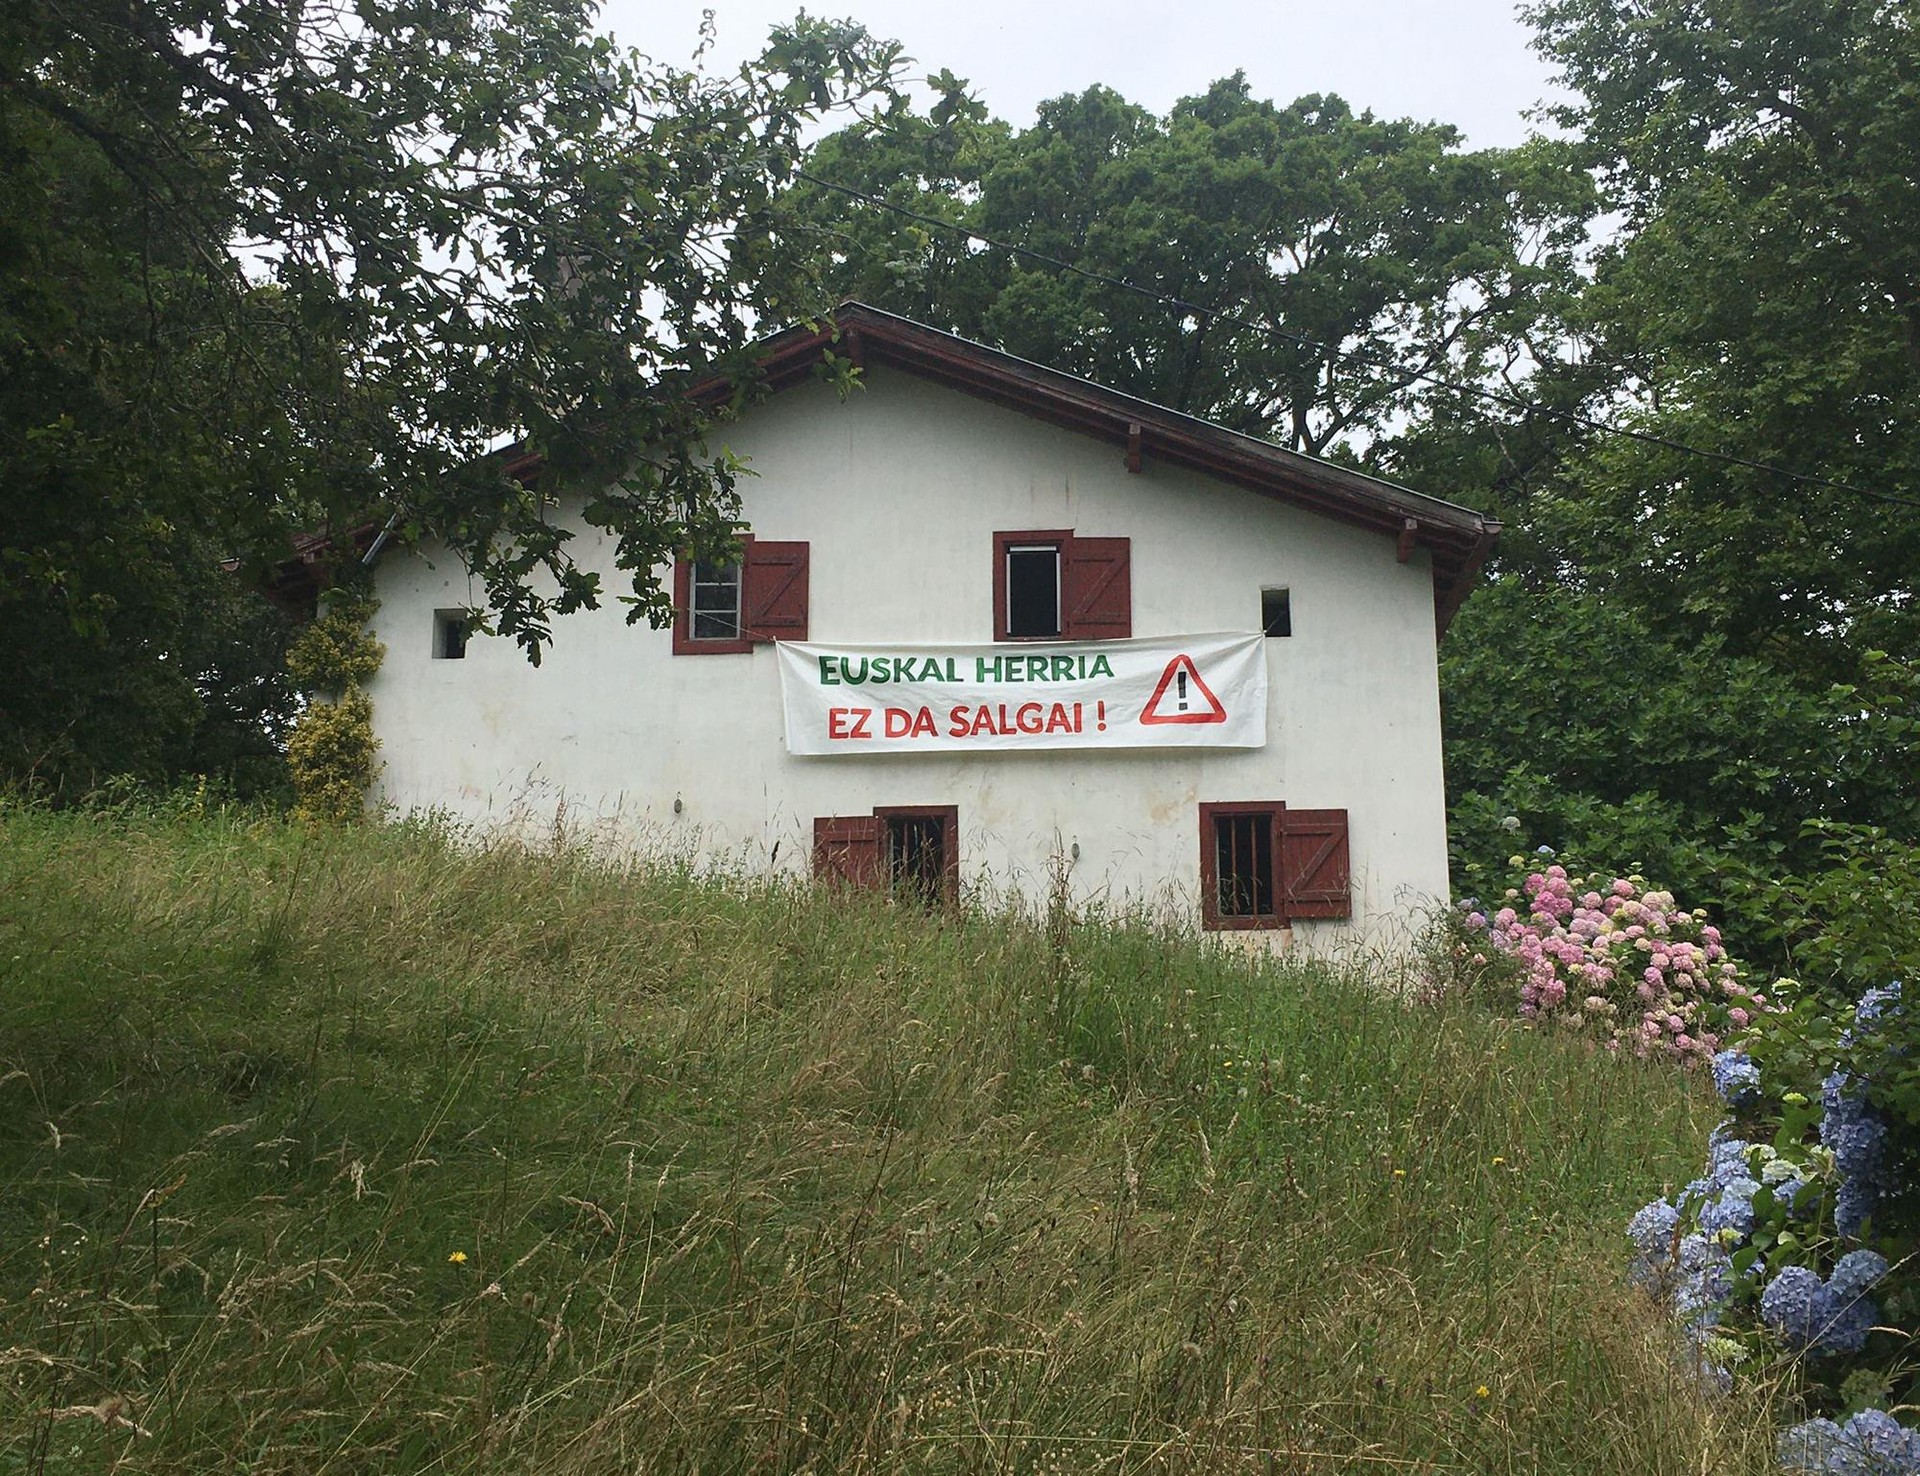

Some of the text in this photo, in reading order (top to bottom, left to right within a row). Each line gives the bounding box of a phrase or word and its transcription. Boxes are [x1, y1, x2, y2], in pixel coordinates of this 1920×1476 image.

[818, 653, 1116, 686] EUSKAL HERRIA
[827, 706, 873, 741] EZ
[884, 705, 938, 739] DA
[948, 701, 1083, 738] SALGAI
